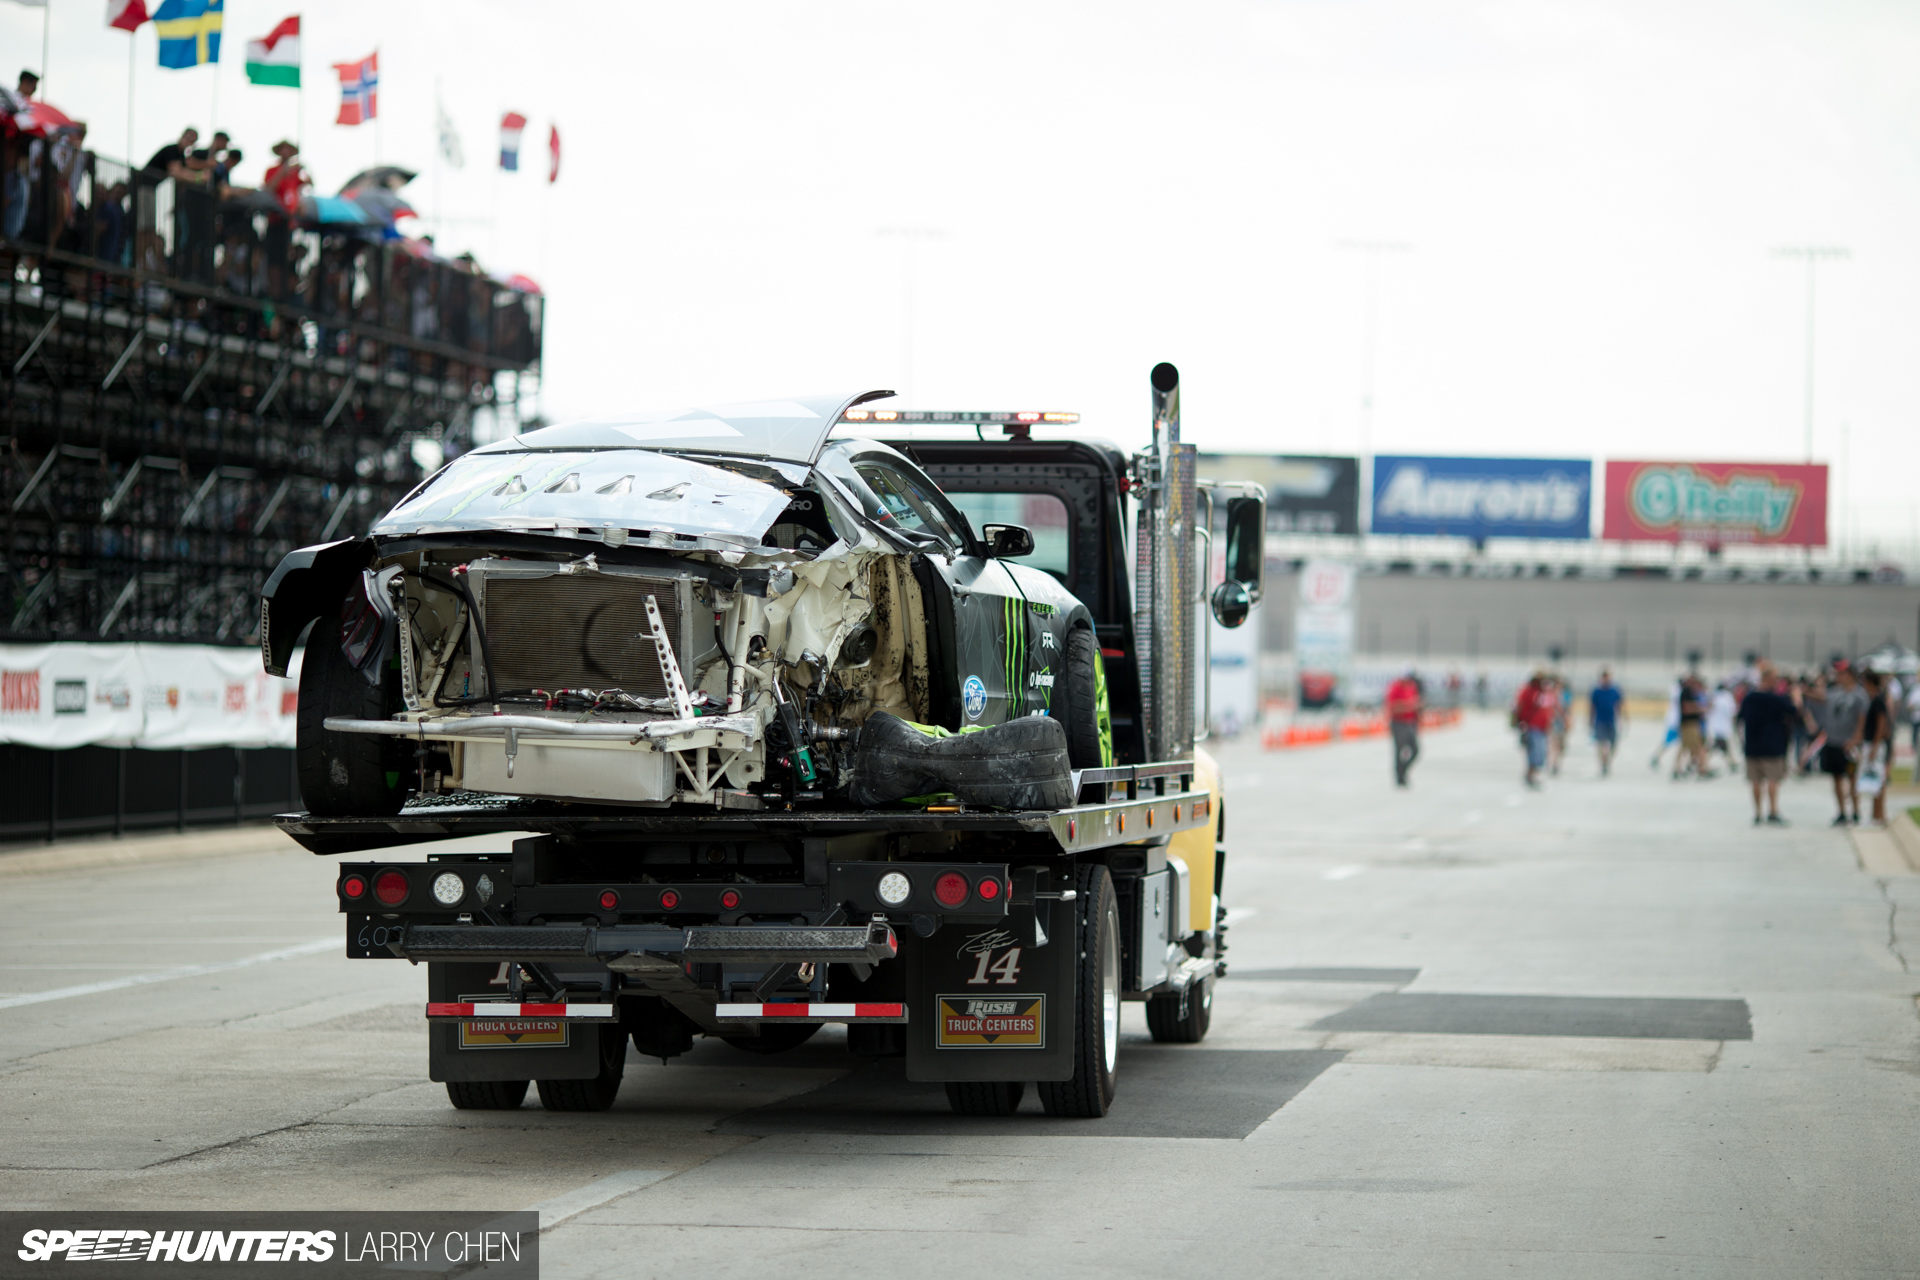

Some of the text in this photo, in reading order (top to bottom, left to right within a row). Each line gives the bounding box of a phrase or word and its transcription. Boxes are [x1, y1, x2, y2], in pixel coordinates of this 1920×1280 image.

[1377, 464, 1582, 523] Aaron's
[1633, 467, 1798, 536] O'Reilly
[968, 682, 983, 711] Ford
[358, 926, 404, 947] 60
[967, 947, 1021, 984] 14
[470, 1022, 558, 1032] TRUCK CENTERS
[948, 1019, 1034, 1031] TRUCK CENTERS
